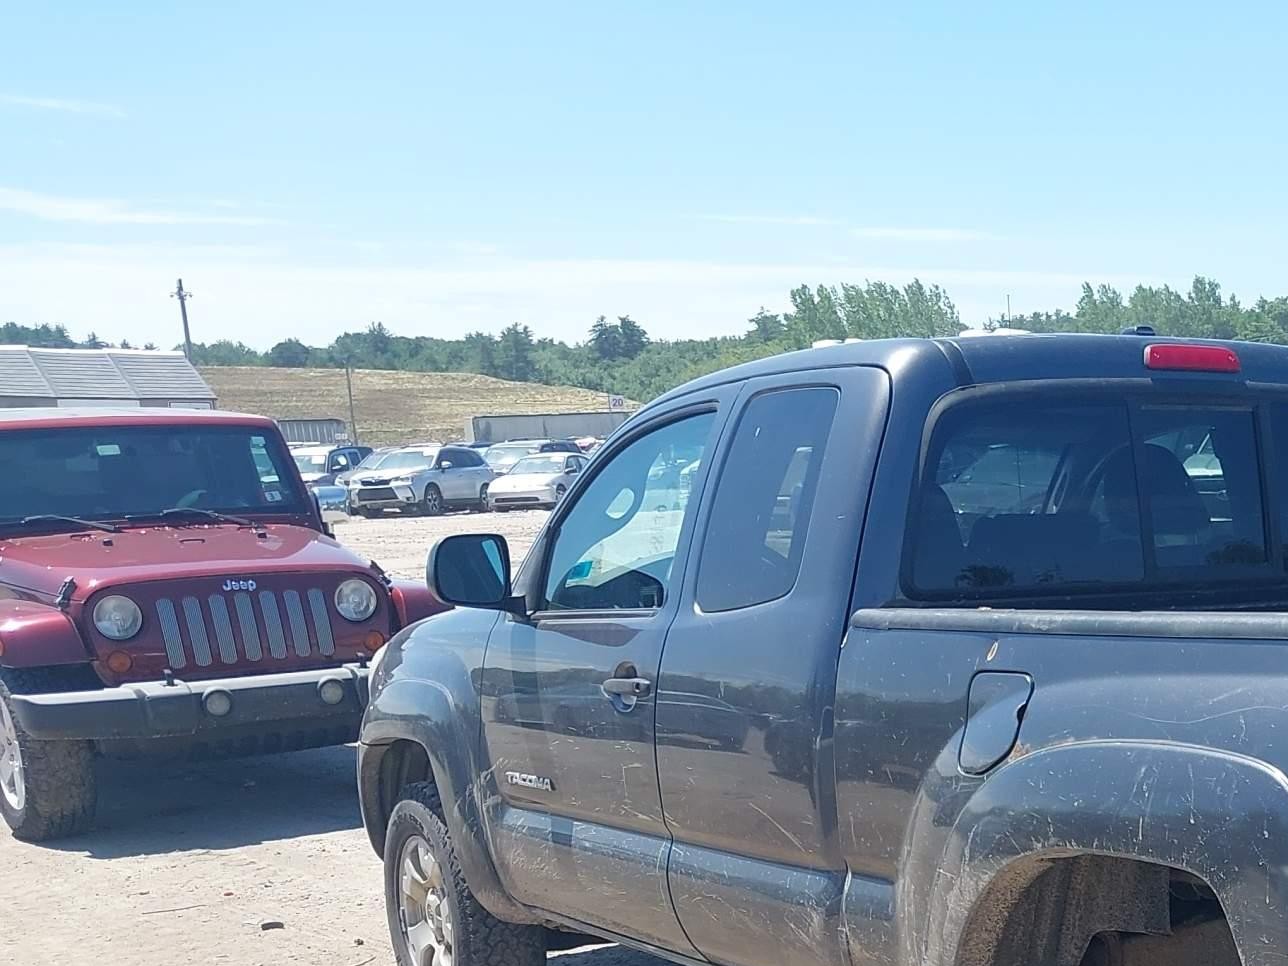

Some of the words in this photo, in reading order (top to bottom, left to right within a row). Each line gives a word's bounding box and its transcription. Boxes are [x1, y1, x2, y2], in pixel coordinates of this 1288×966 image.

[612, 398, 624, 407] 20
[222, 579, 257, 591] Jeep
[504, 771, 553, 792] TACOMA
